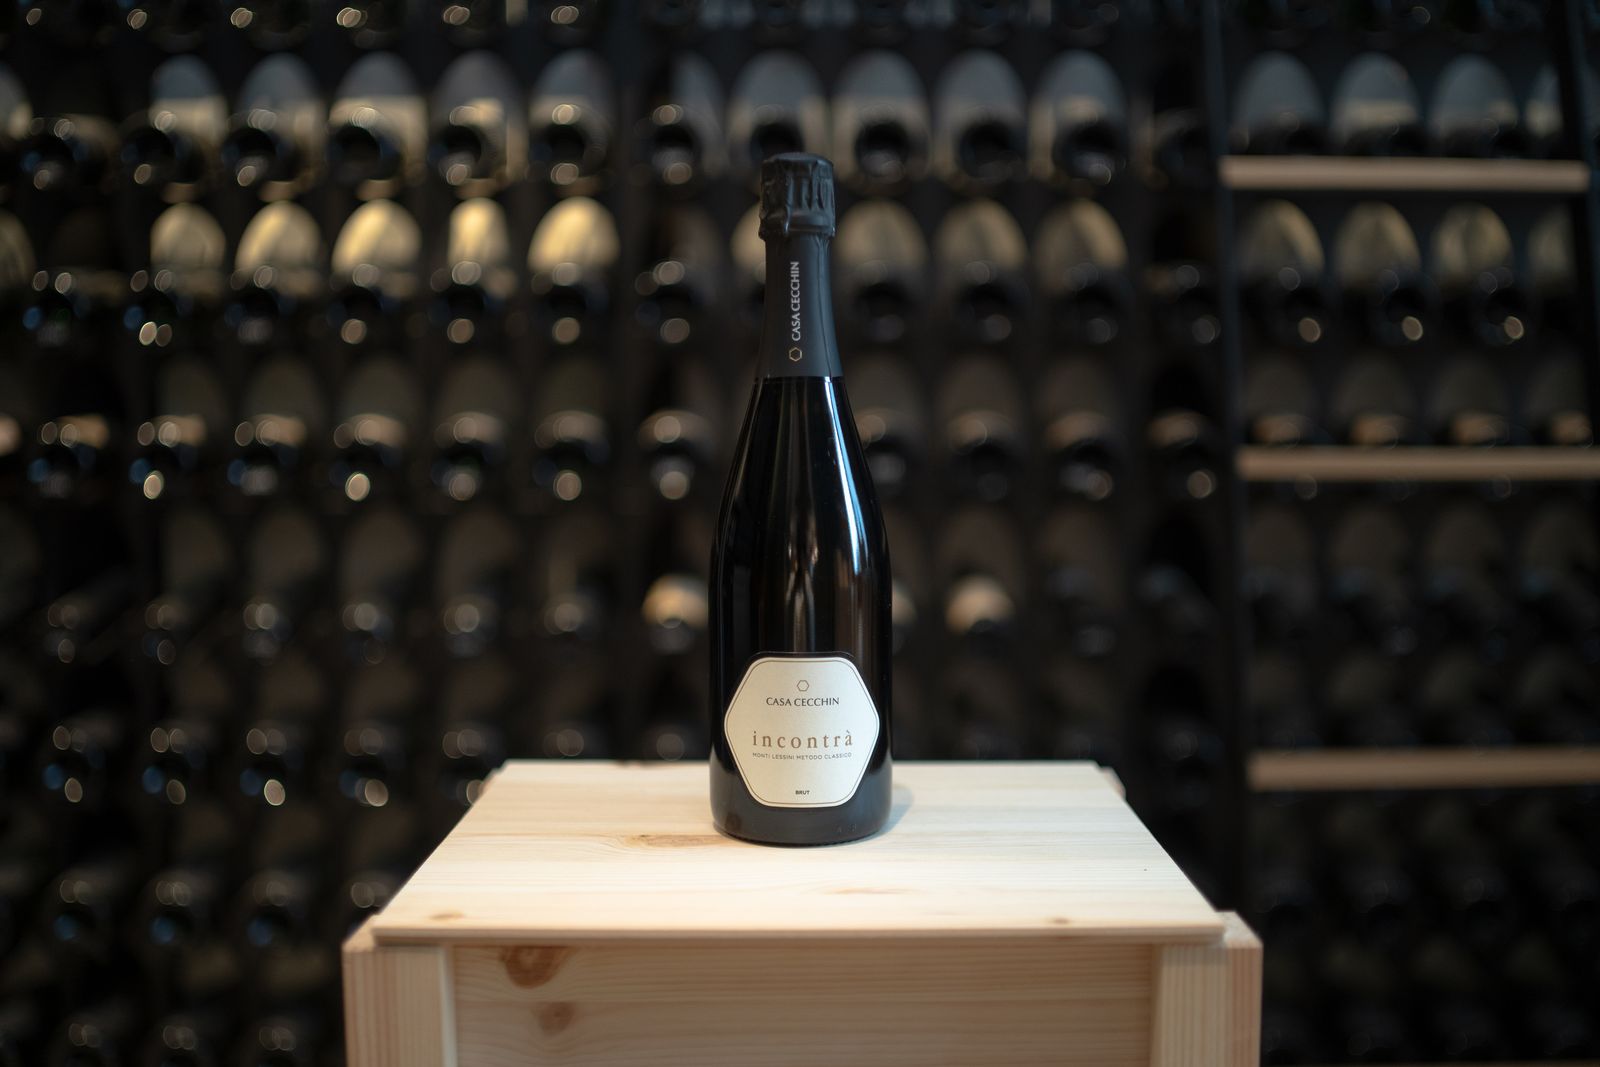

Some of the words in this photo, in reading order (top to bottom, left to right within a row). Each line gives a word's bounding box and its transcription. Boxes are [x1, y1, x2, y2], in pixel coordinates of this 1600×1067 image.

[790, 261, 800, 312] CECCHIN
[791, 312, 801, 341] CASA
[766, 697, 792, 706] CASA
[794, 697, 839, 706] CECCHIN
[752, 730, 853, 749] incontrà
[825, 752, 852, 760] CLASSICO
